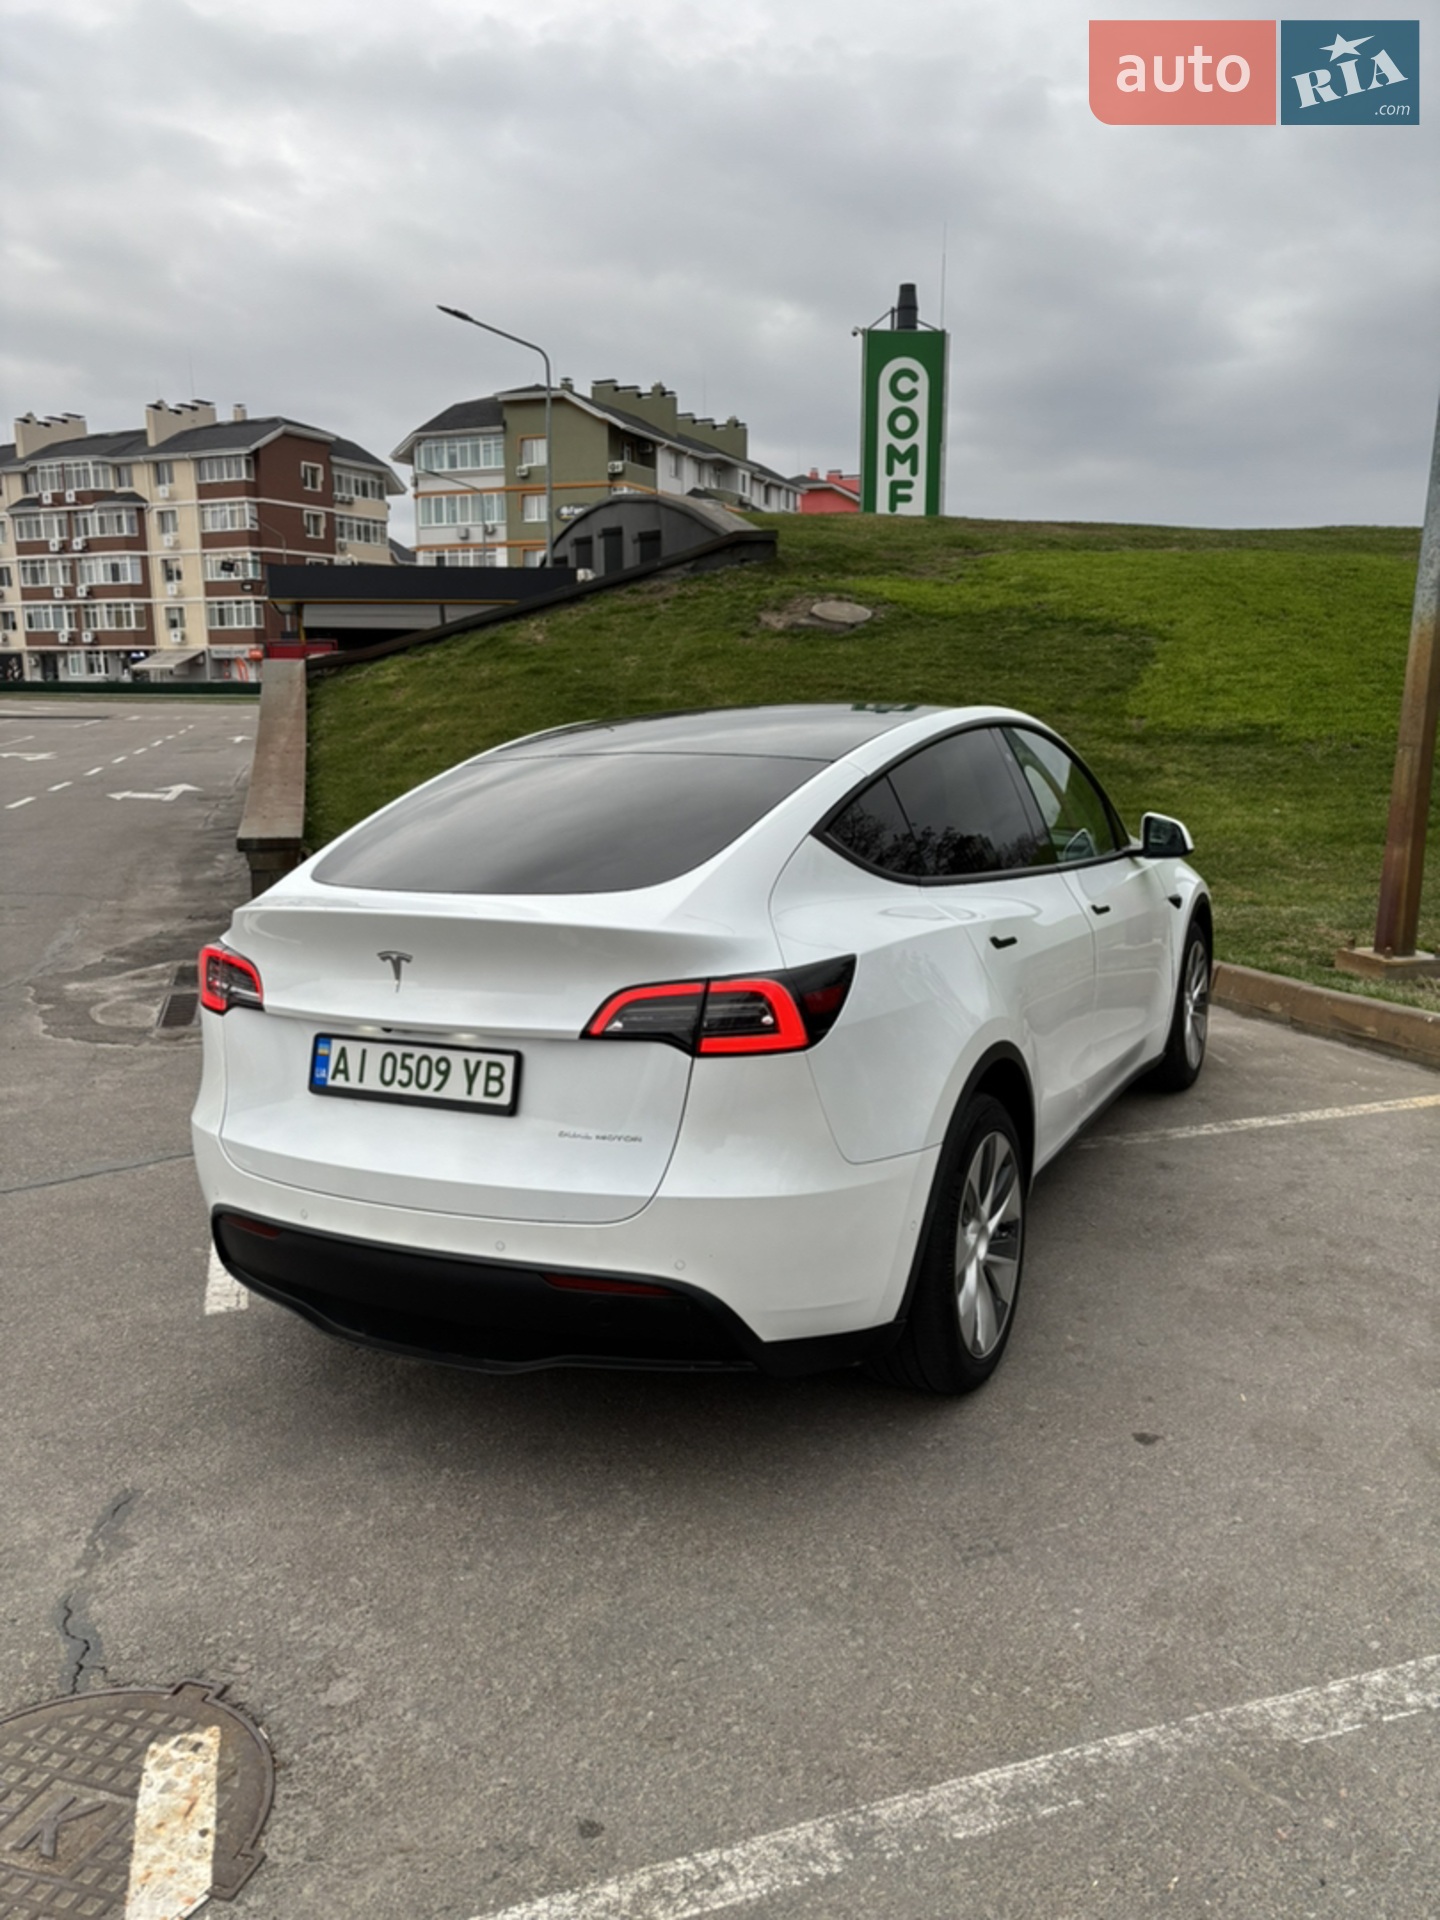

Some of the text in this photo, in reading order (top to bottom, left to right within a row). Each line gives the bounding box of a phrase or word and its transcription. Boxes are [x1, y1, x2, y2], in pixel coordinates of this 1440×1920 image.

[886, 368, 920, 514] COMF
[330, 1046, 505, 1098] AI 0509 YB
